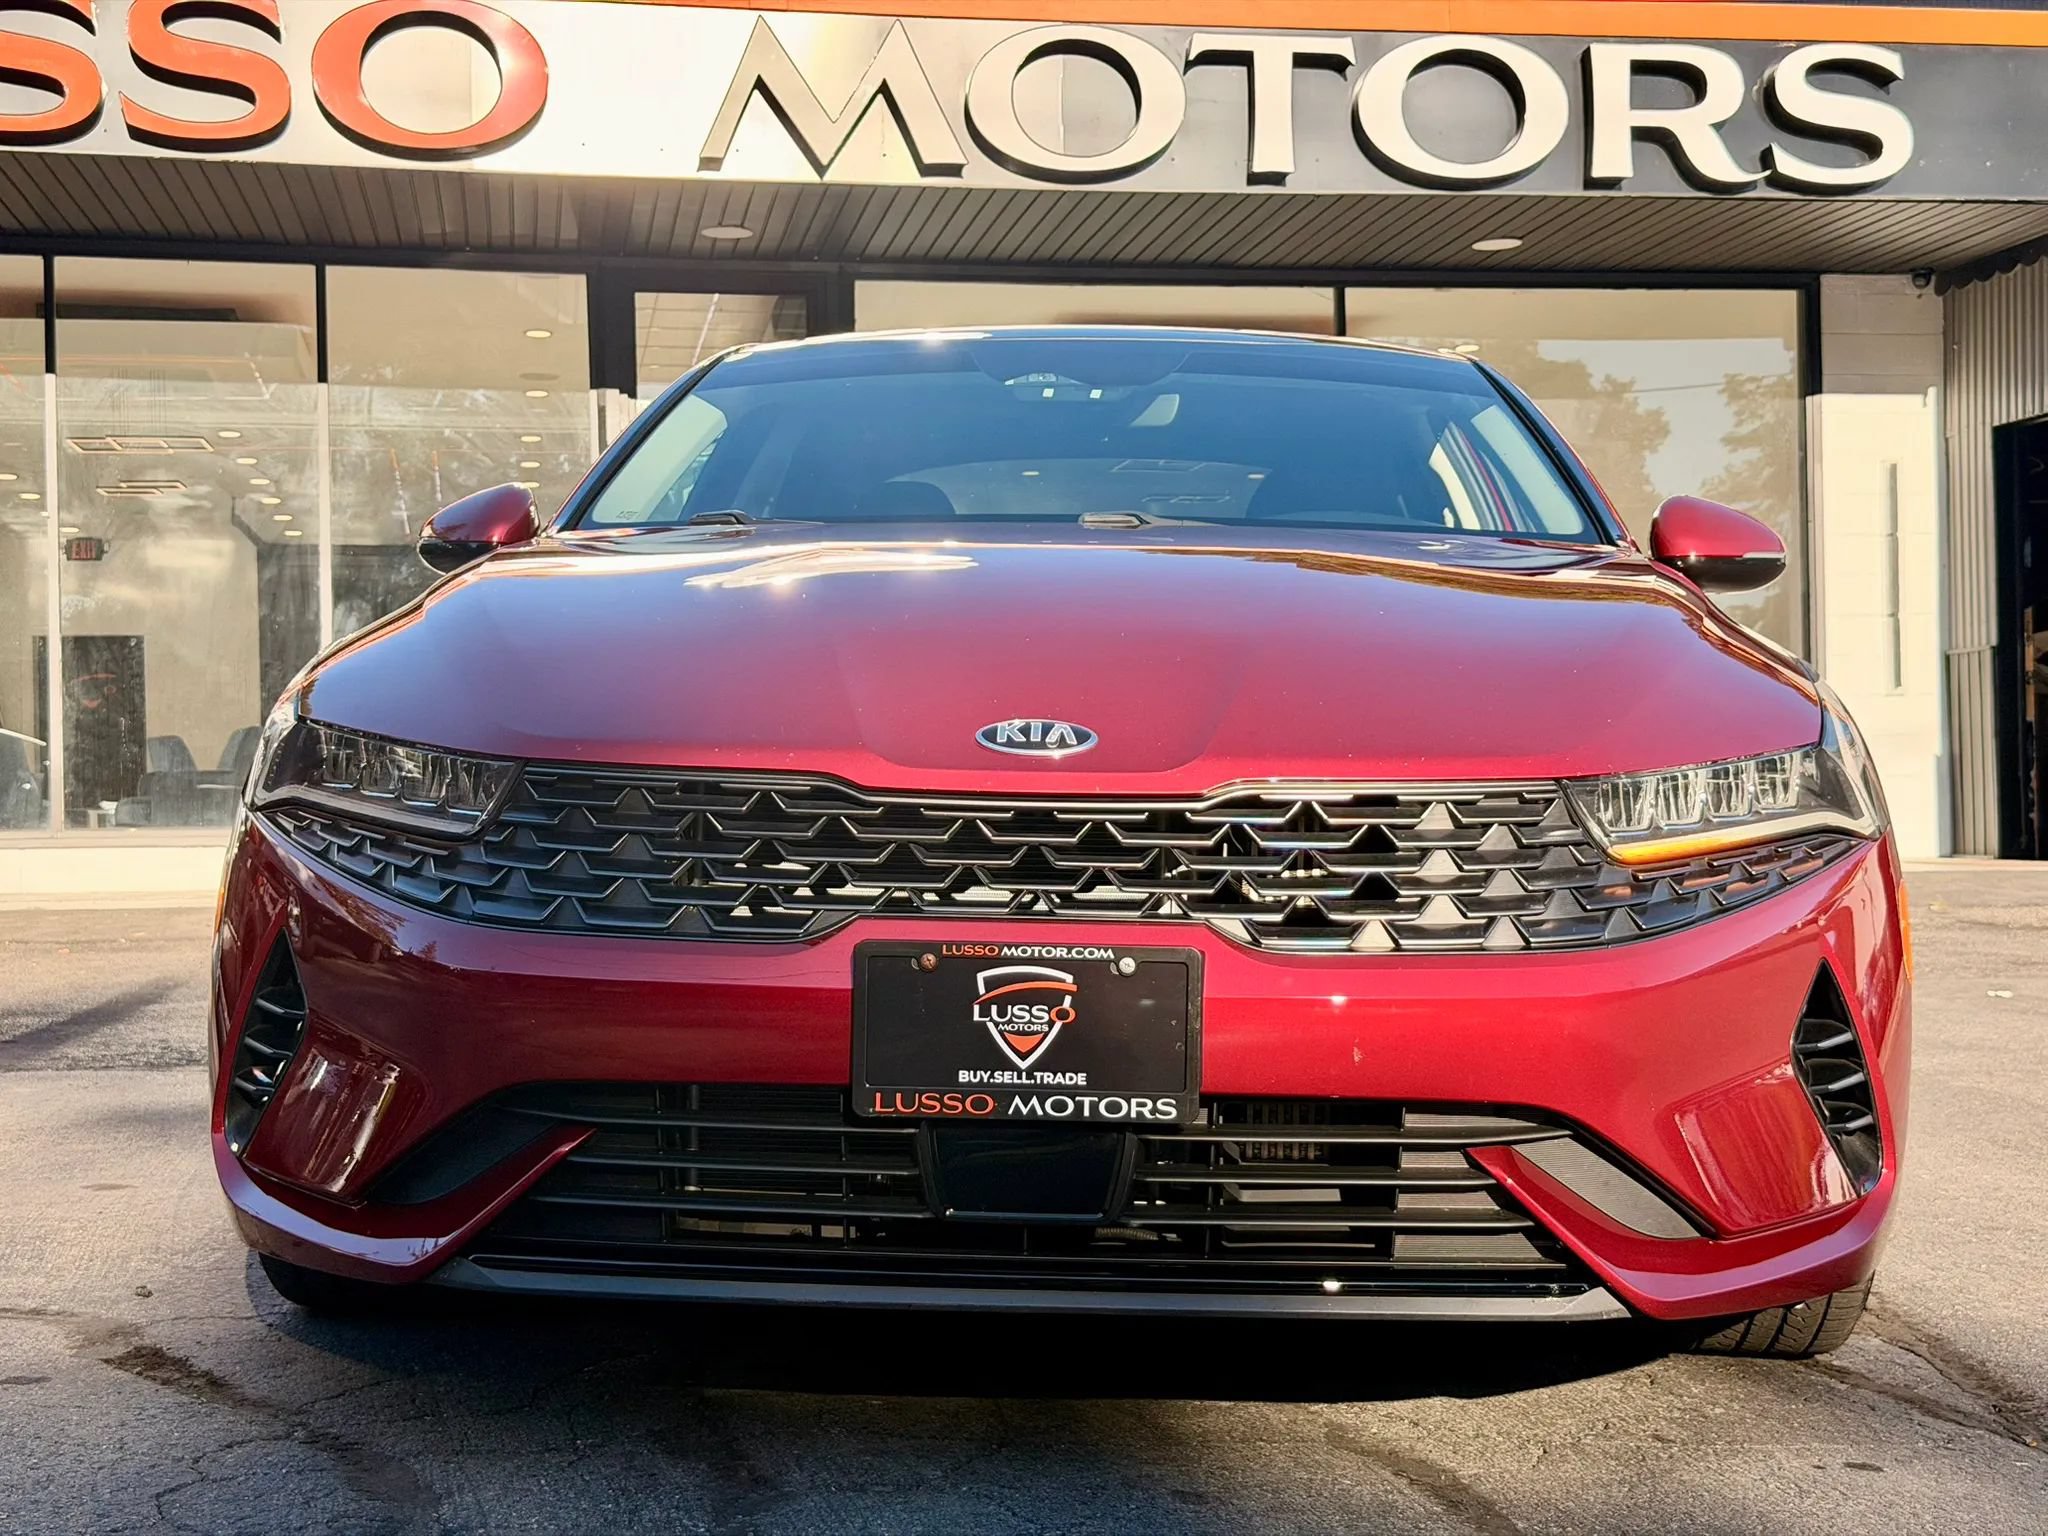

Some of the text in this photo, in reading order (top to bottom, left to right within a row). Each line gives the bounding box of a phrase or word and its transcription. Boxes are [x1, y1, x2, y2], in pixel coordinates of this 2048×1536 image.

[698, 14, 1914, 194] MOTORS
[71, 540, 97, 559] EXIT
[996, 721, 1078, 747] KIA
[973, 1003, 1077, 1024] LUSSO
[997, 1023, 1050, 1033] MOTORS
[957, 1070, 1088, 1086] BUY.SELL.TRADE
[873, 1091, 1178, 1120] LUSSO MOTORS
